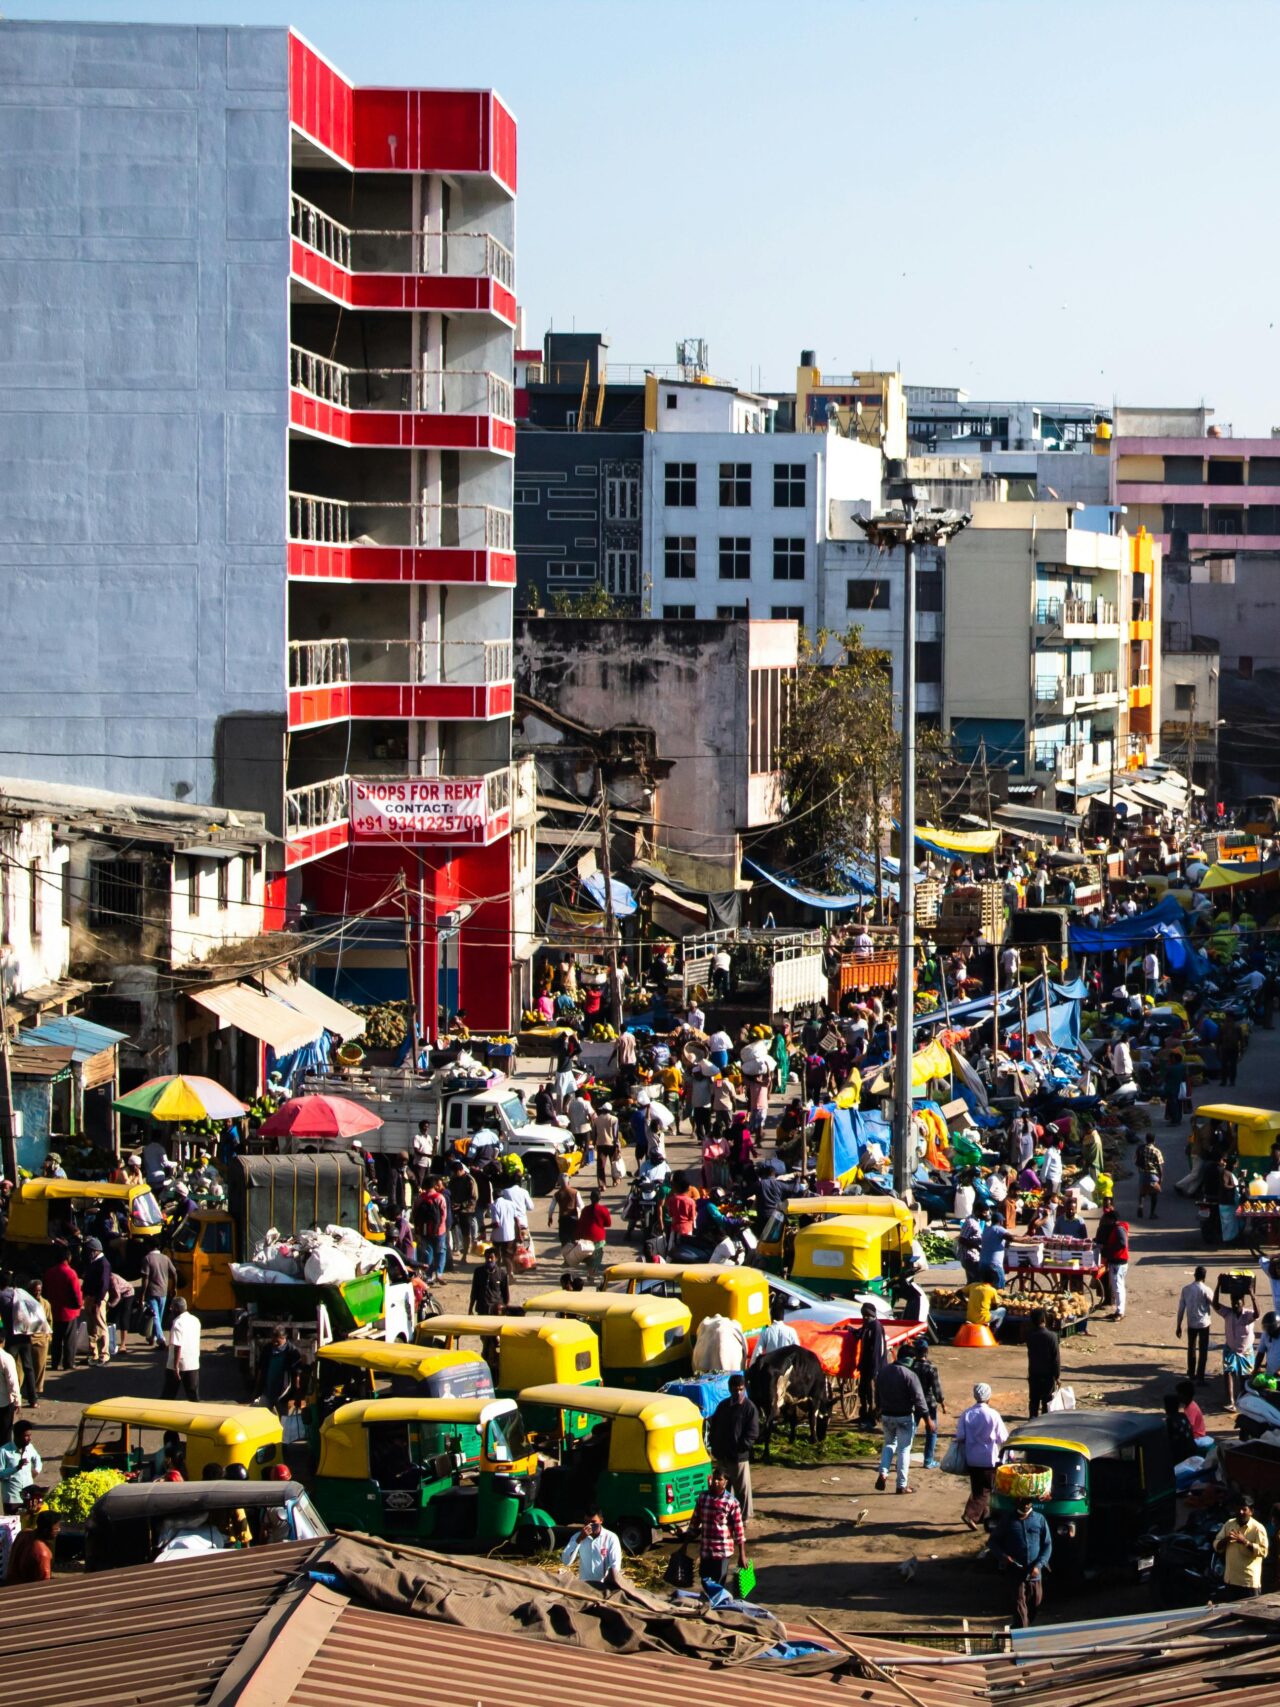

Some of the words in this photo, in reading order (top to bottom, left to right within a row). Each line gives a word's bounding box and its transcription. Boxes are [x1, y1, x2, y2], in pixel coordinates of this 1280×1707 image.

[357, 784, 405, 801] SHOPS
[410, 784, 439, 801] FOR
[444, 783, 482, 800] RENT
[385, 804, 453, 813] CONTACT:
[356, 815, 382, 831] +91
